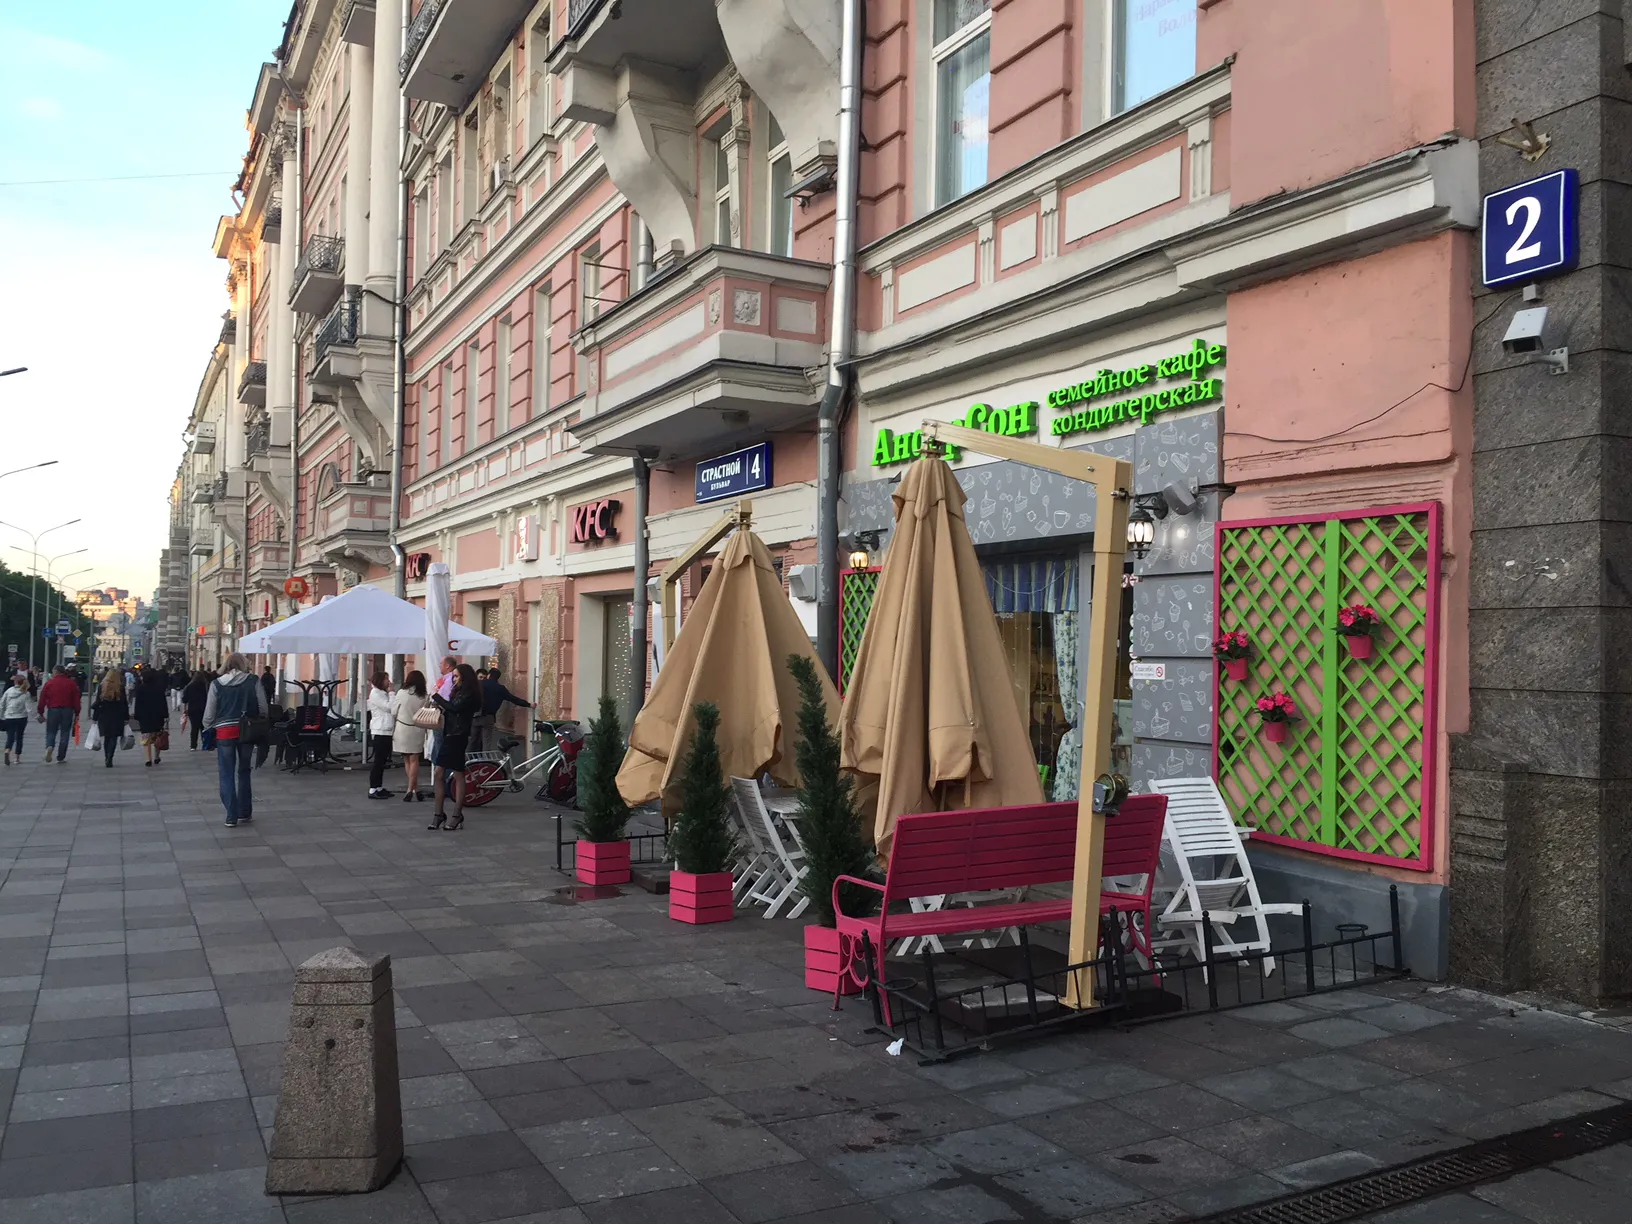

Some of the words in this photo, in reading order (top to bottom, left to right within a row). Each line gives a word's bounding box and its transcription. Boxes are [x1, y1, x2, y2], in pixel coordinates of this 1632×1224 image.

[1505, 196, 1541, 265] 2
[1046, 364, 1152, 409] семейное
[1156, 338, 1224, 381] кафе
[1050, 378, 1219, 436] кондитерская
[701, 458, 741, 483] СТРАСТНОЙ
[751, 453, 761, 480] 4
[570, 499, 610, 543] KFC
[405, 554, 422, 579] KFC
[558, 759, 578, 778] KF
